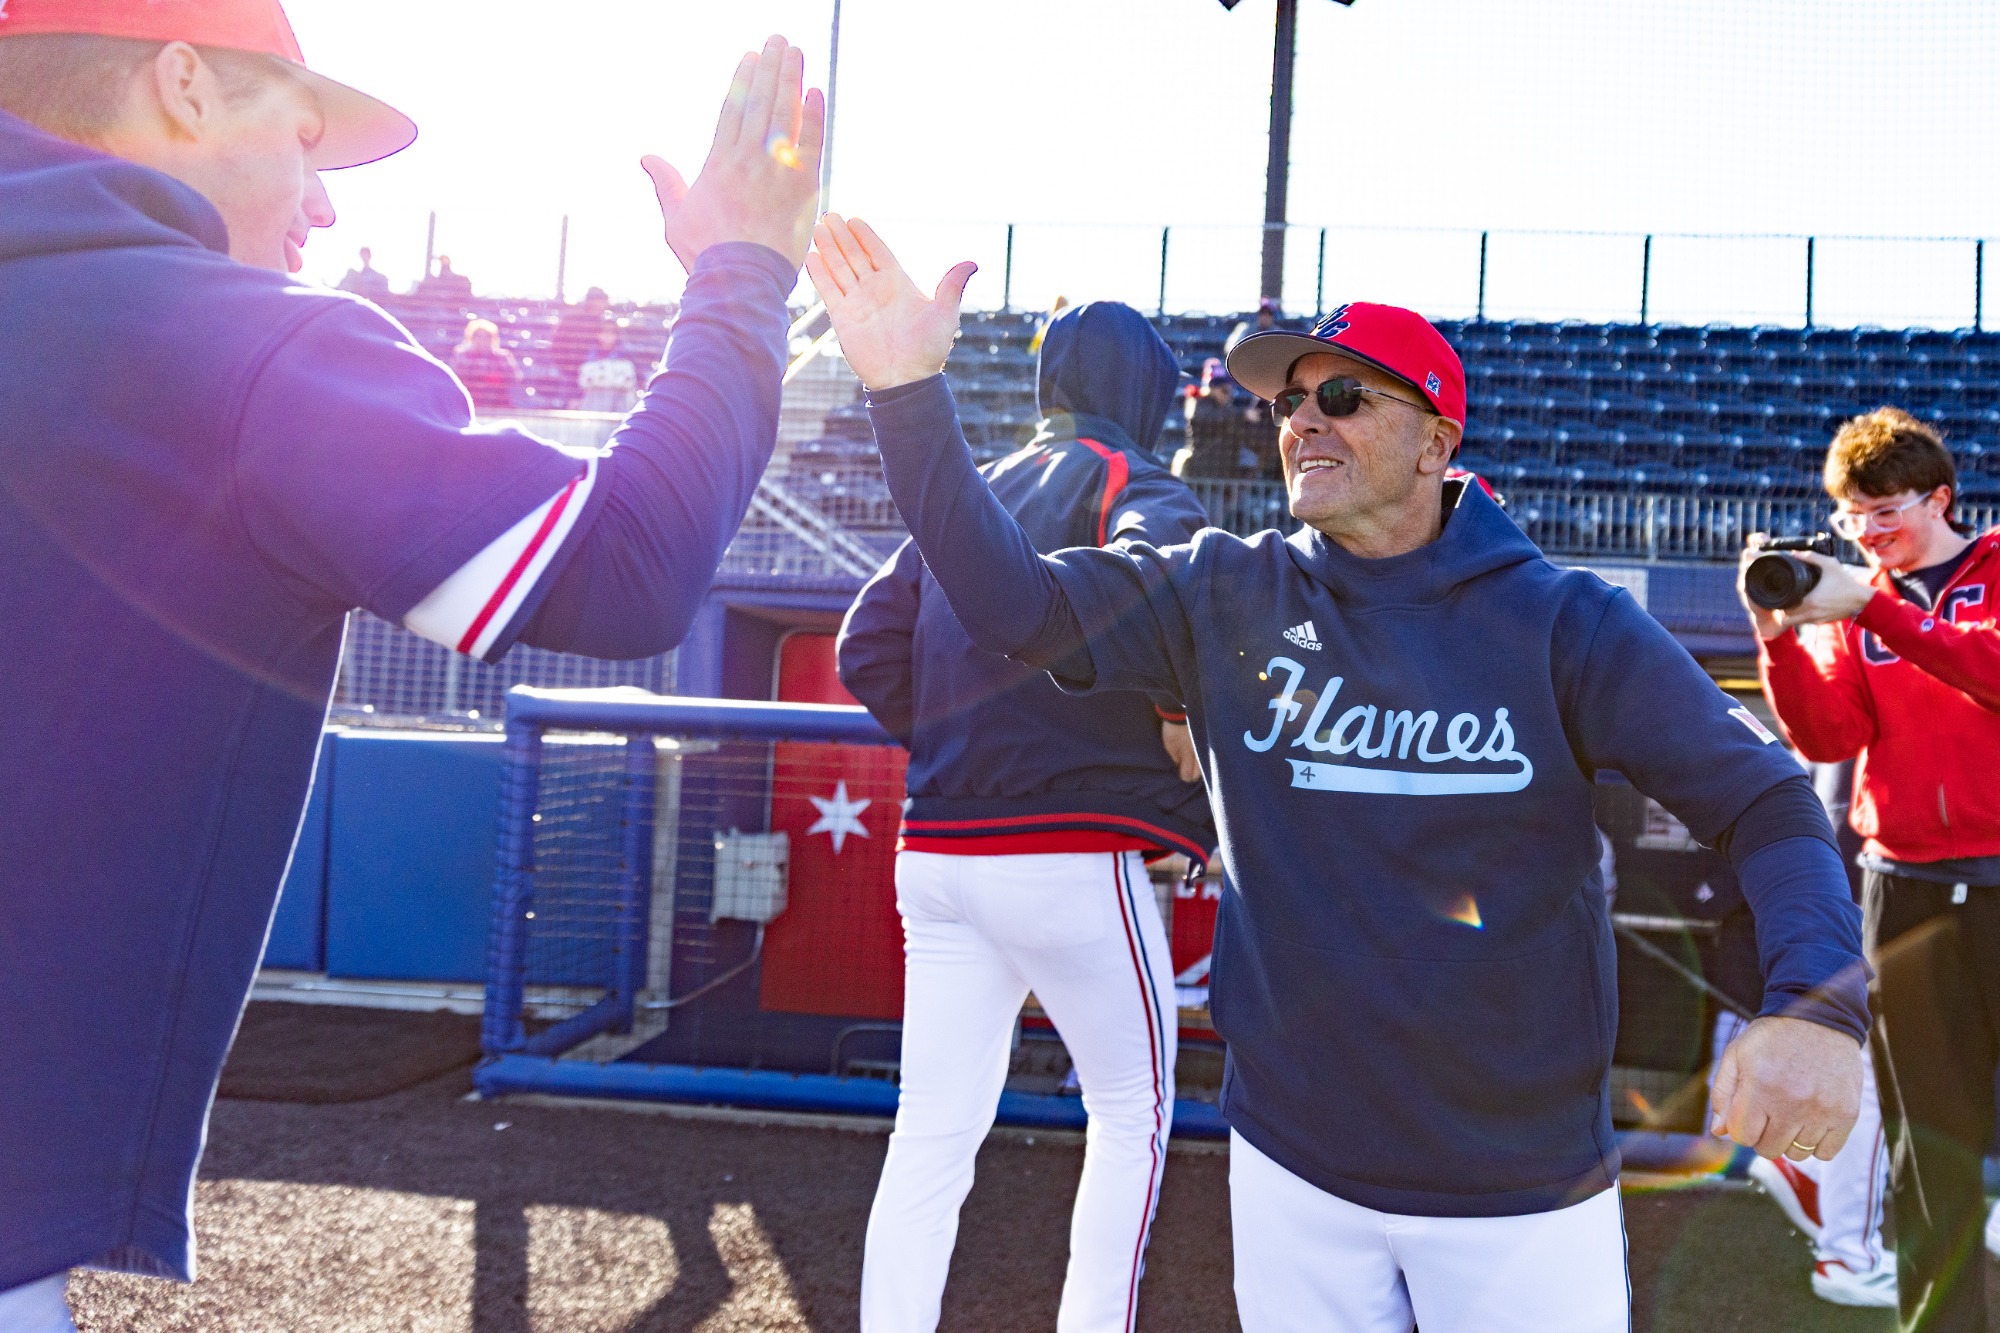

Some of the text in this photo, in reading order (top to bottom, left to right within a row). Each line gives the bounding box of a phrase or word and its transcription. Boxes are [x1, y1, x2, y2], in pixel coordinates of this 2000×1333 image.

[1283, 630, 1323, 651] adidas
[1244, 656, 1520, 763] Flames
[1300, 765, 1316, 783] 4
